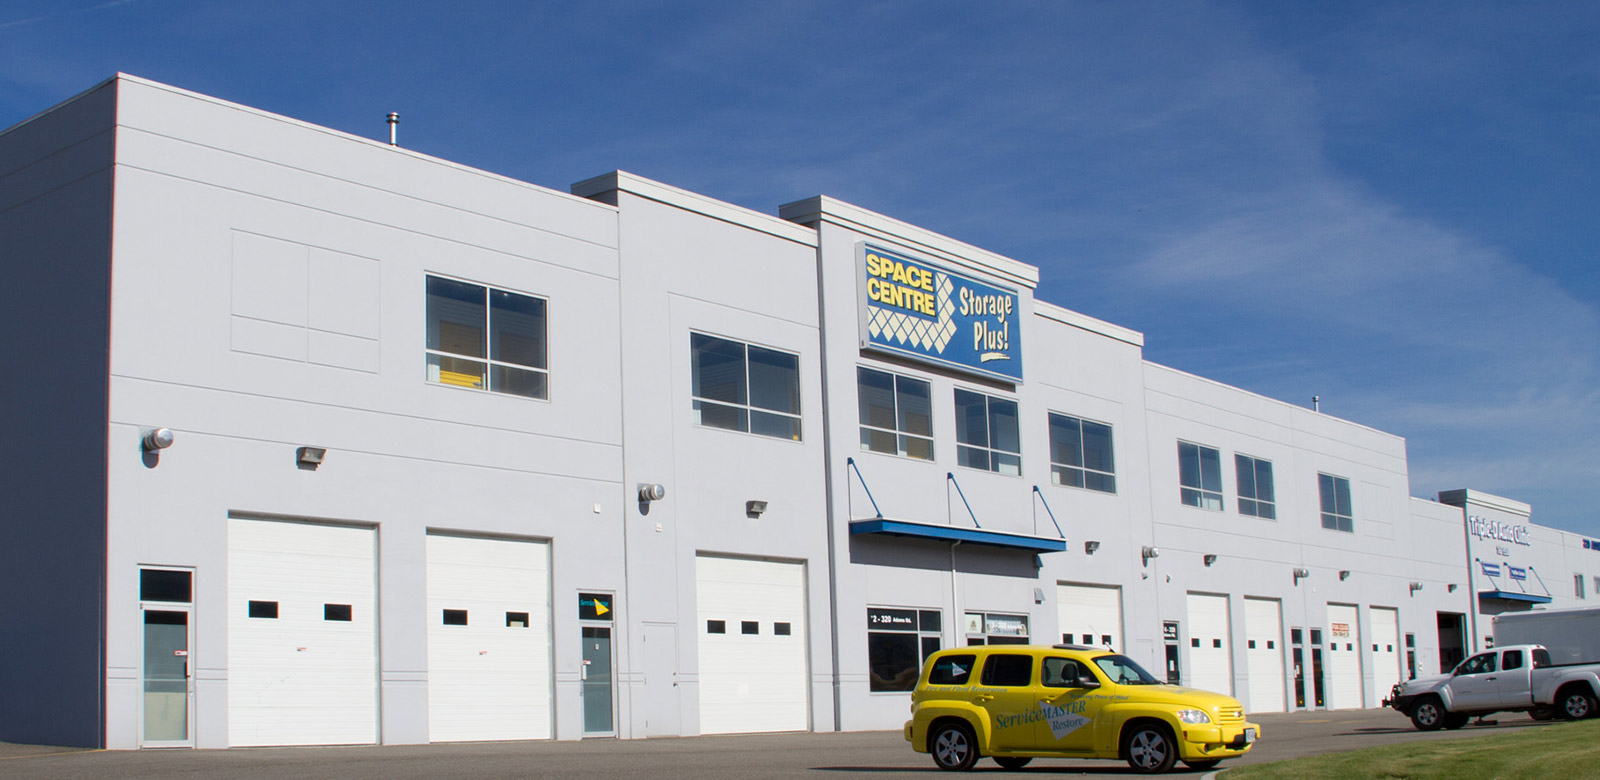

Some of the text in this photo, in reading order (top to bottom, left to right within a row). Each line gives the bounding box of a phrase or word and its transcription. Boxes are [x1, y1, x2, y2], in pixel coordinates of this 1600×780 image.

[866, 253, 934, 292] SPACE
[867, 277, 936, 316] CENTRE
[959, 286, 1012, 323] Storage
[973, 320, 1009, 351] Plus!
[881, 615, 891, 623] 320
[996, 700, 1087, 729] ServiceMASTER
[1053, 717, 1084, 731] Restore
